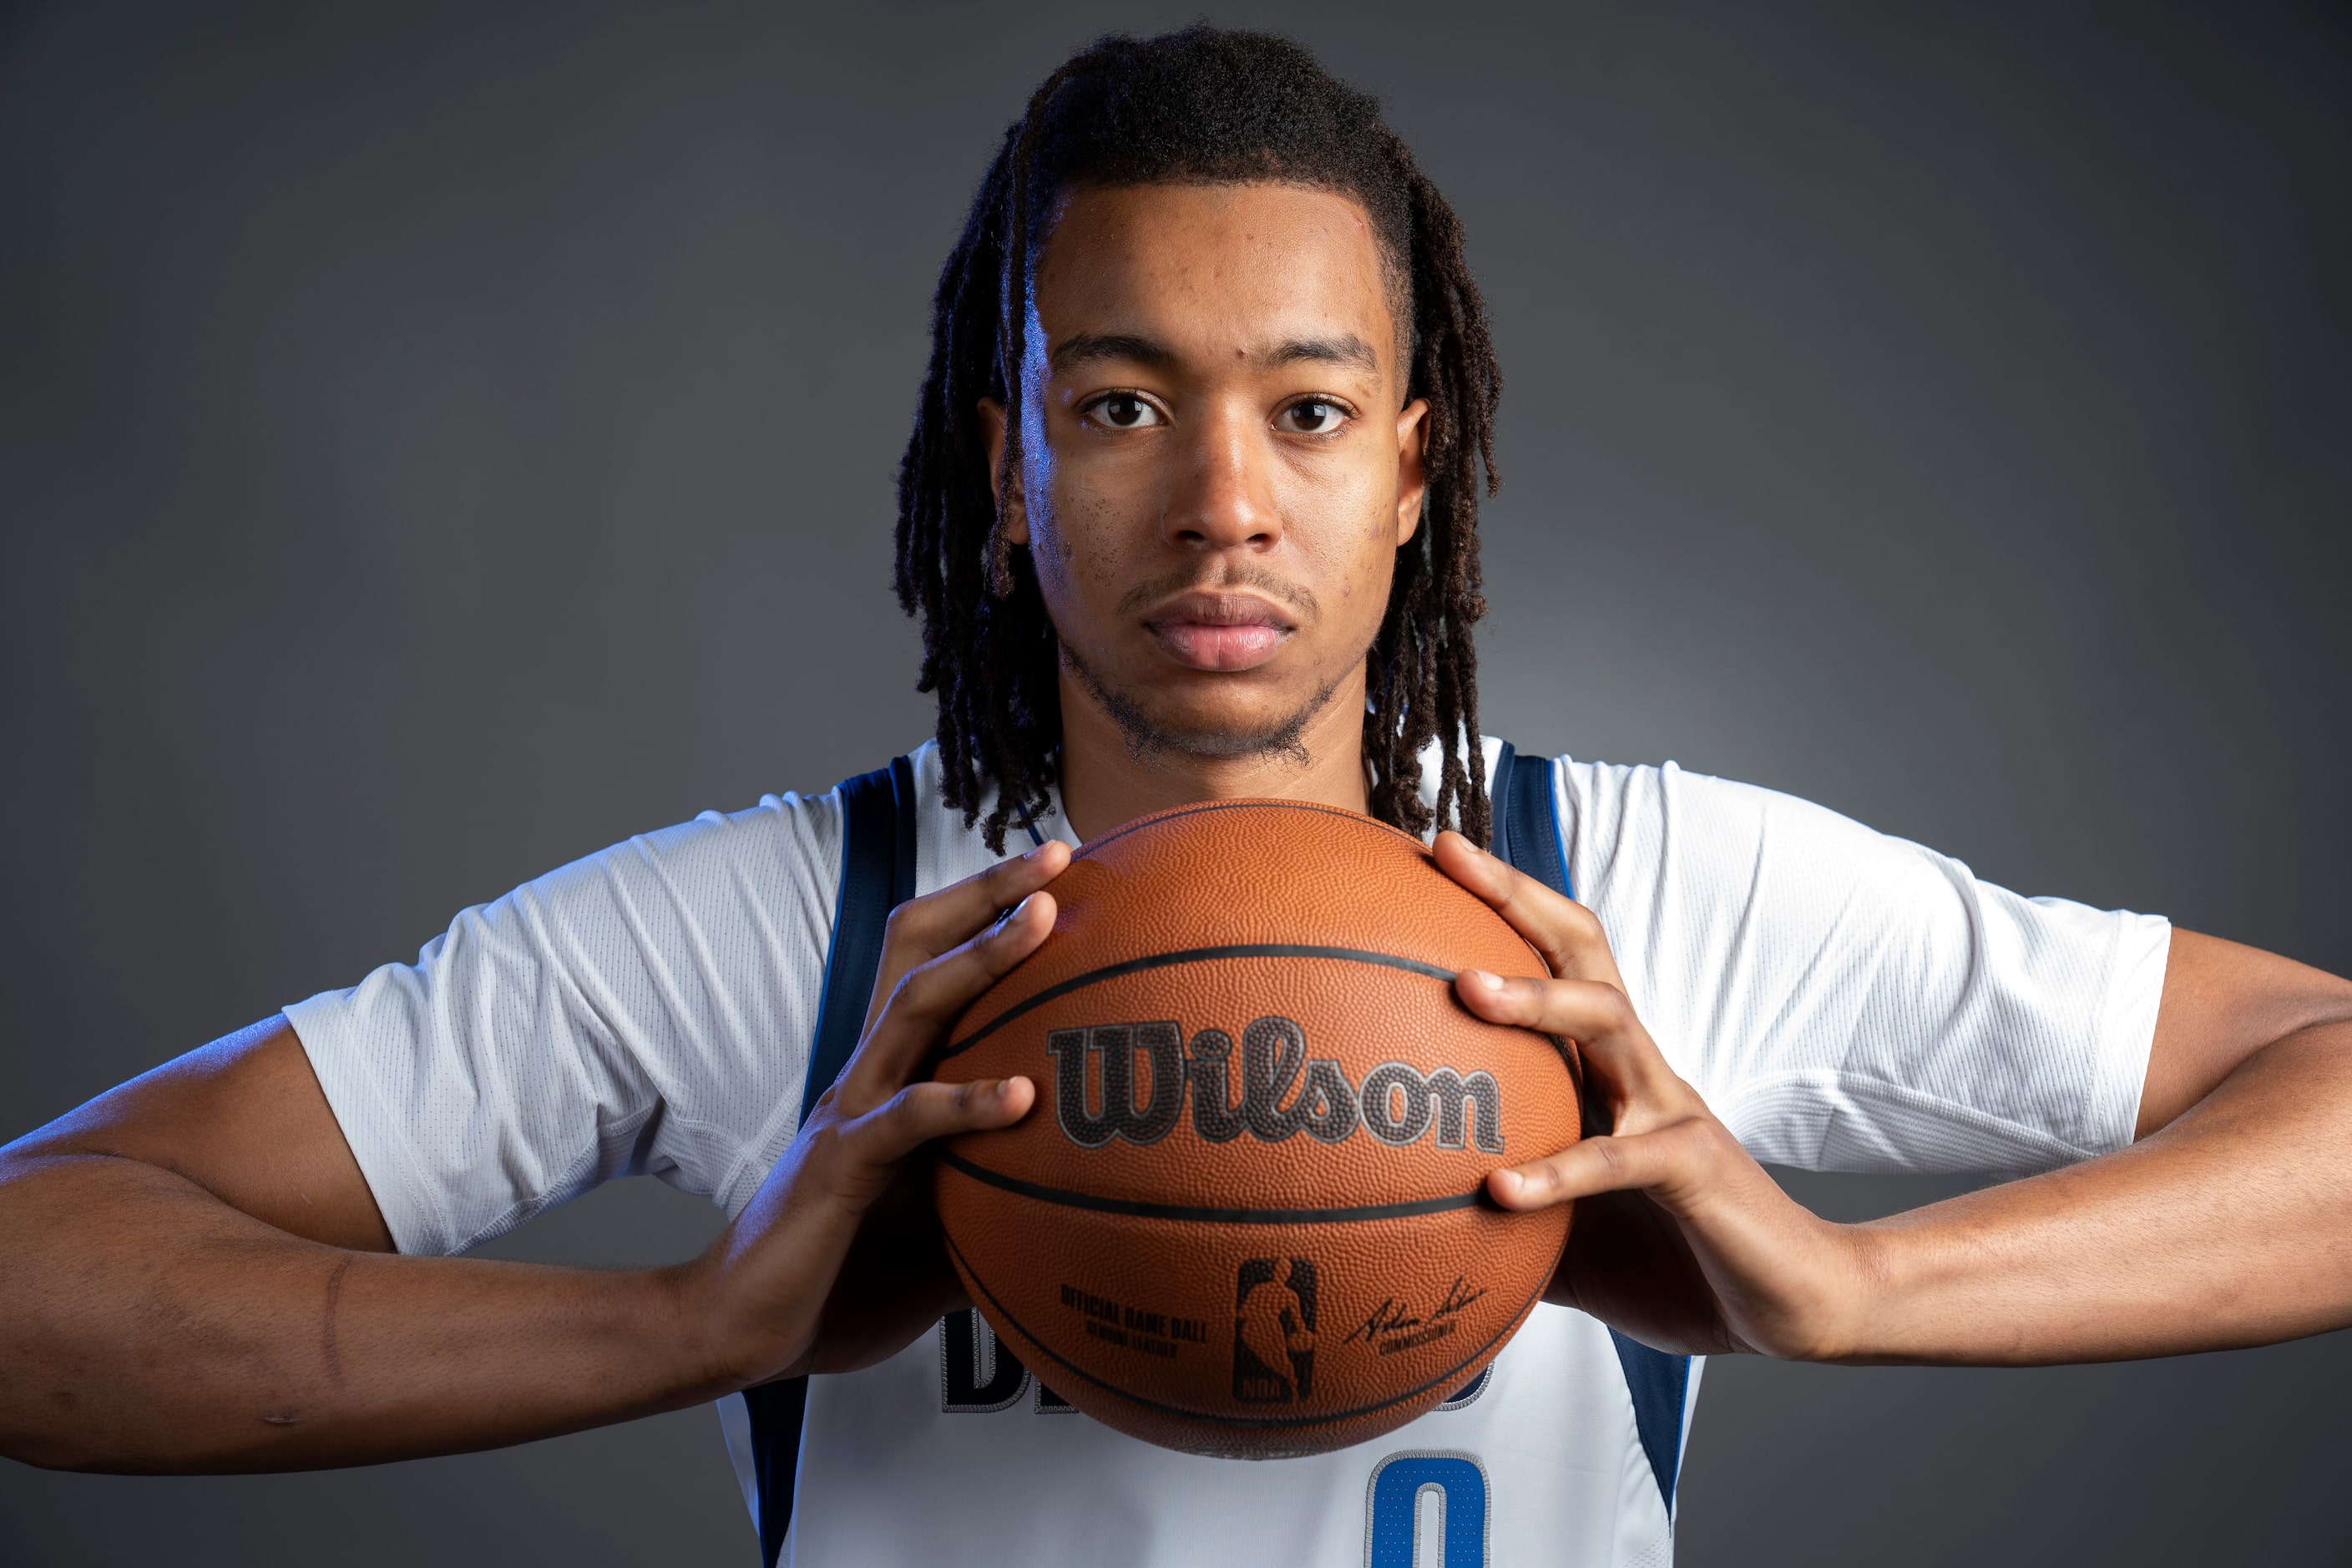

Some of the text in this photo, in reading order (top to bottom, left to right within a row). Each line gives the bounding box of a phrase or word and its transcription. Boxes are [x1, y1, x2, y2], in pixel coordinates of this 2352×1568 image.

[1047, 1015, 1505, 1155] Wilson
[1060, 1283, 1207, 1343] OFFICIAL GAME BALL
[1087, 1319, 1177, 1359] GENUINE LEATHER
[1379, 1320, 1455, 1356] COMMISSIONER
[1242, 1378, 1281, 1399] NBA
